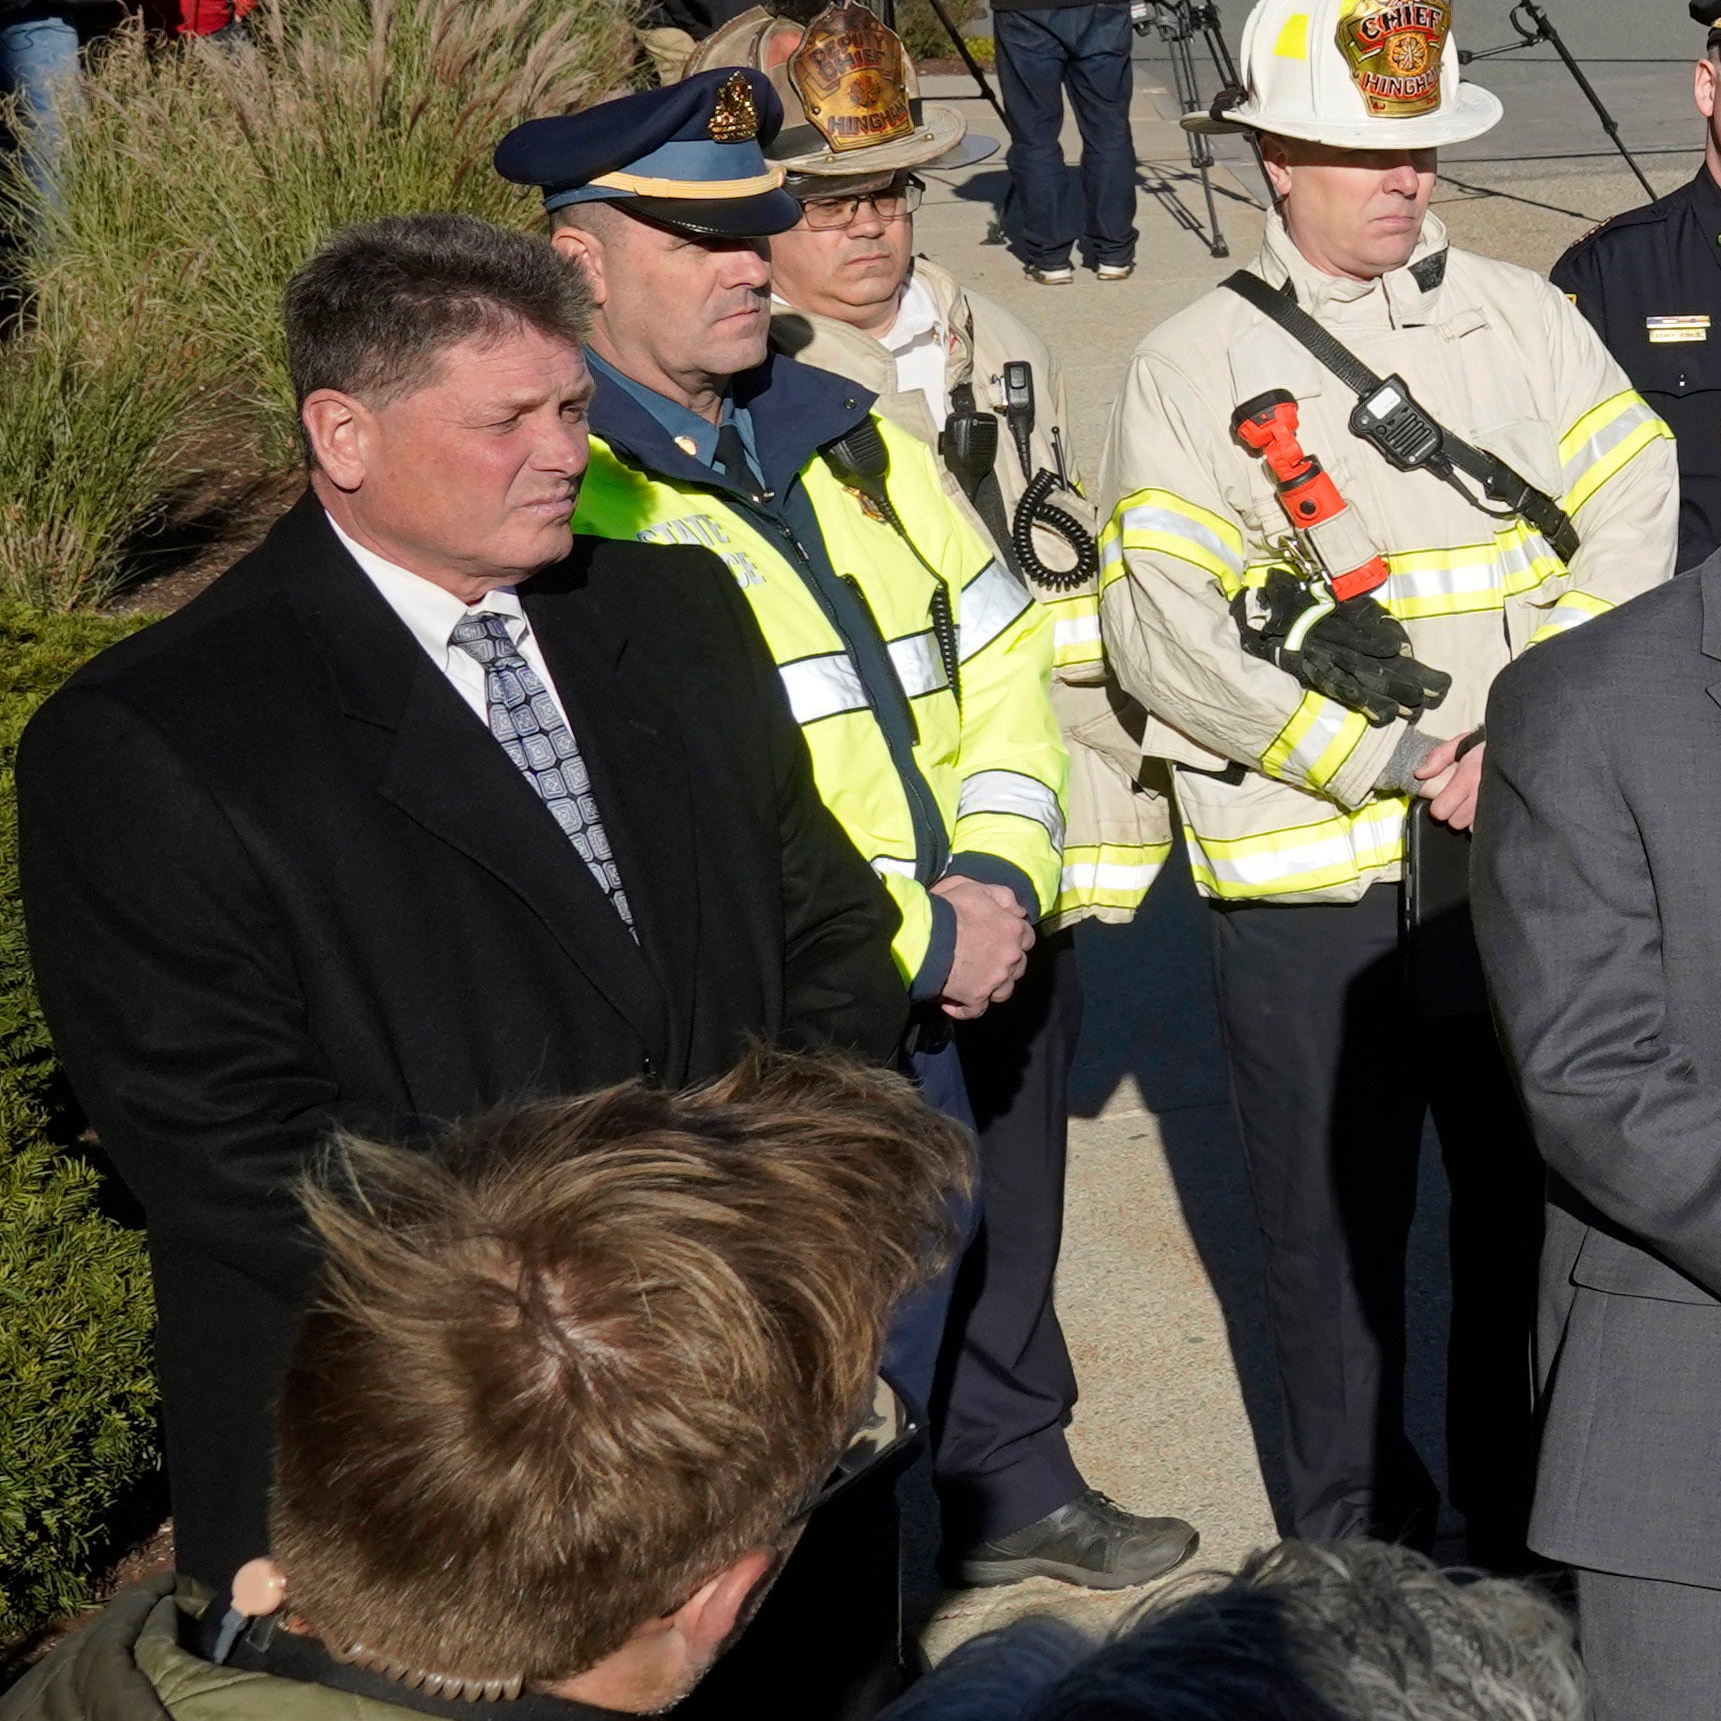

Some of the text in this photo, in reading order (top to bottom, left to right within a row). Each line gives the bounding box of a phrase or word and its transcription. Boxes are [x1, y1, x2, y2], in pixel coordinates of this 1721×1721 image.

[1358, 3, 1445, 42] CHIEF
[809, 30, 885, 67] DEPUTY
[819, 48, 886, 79] CHIEF
